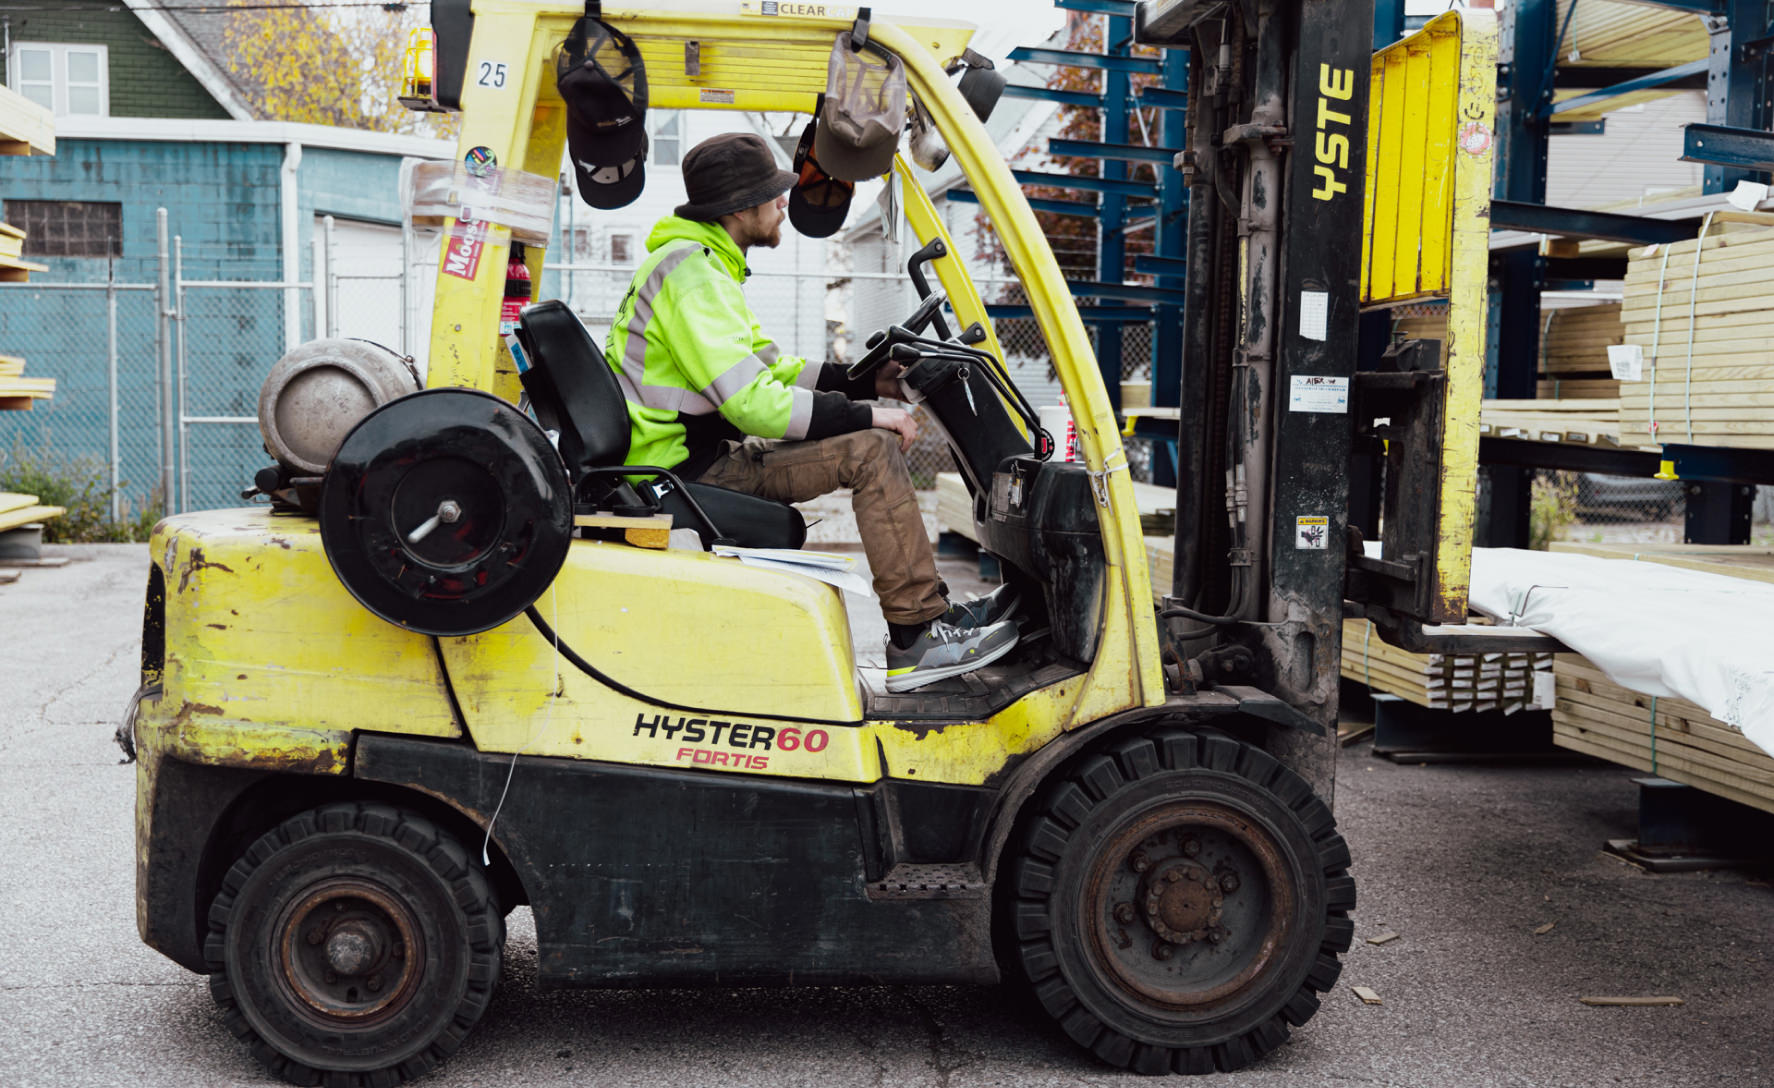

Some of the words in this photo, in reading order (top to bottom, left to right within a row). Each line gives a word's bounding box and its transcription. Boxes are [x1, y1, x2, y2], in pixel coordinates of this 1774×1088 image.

[478, 61, 507, 88] 25
[1312, 62, 1354, 201] YSTE
[633, 713, 776, 751] HYSTER
[776, 727, 830, 752] 60
[676, 747, 769, 770] FORTIS
